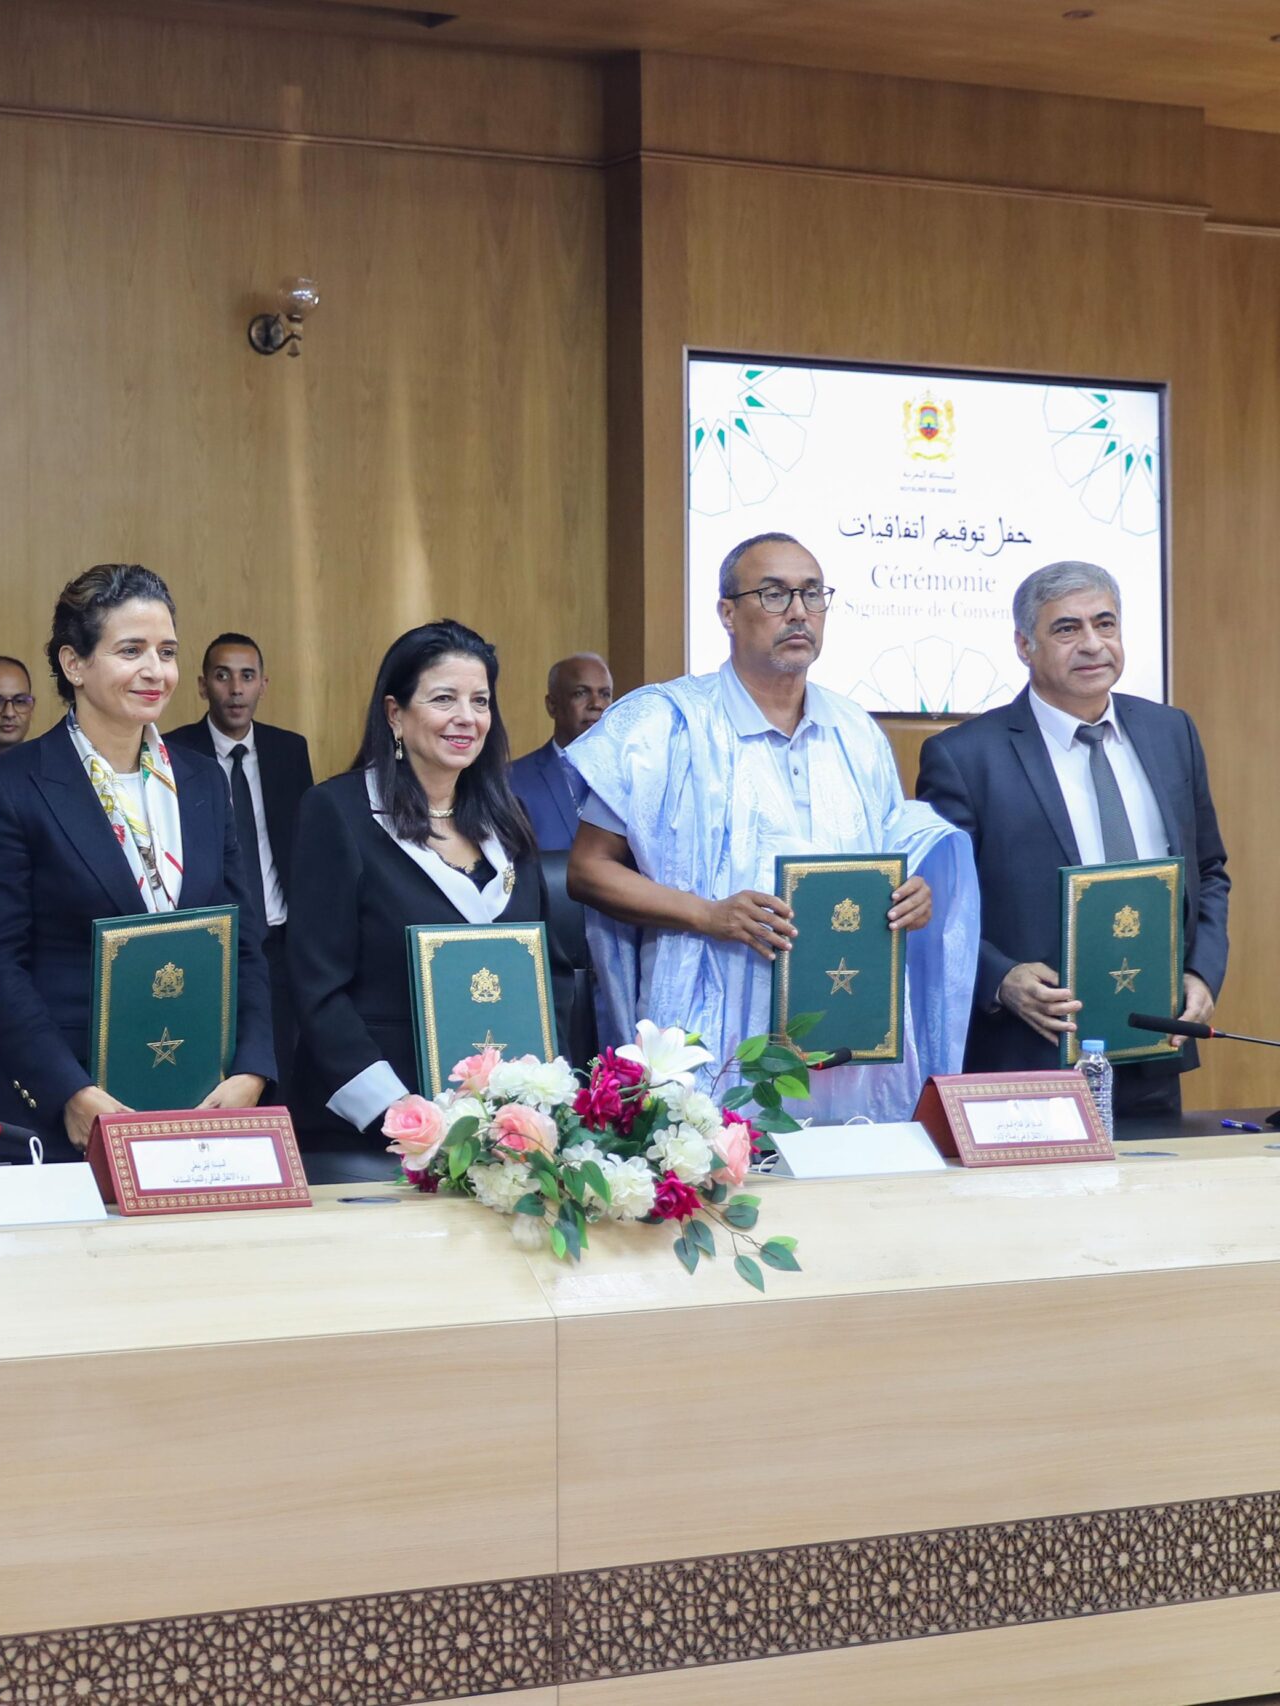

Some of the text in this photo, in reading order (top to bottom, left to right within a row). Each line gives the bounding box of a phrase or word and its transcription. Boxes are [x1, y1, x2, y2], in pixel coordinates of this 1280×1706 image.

[837, 513, 1032, 557] حفل توقيع اتفاقيات
[871, 563, 997, 593] Cérémonie
[844, 600, 924, 619] Signature
[927, 600, 946, 617] de
[951, 601, 1011, 620] Conven
